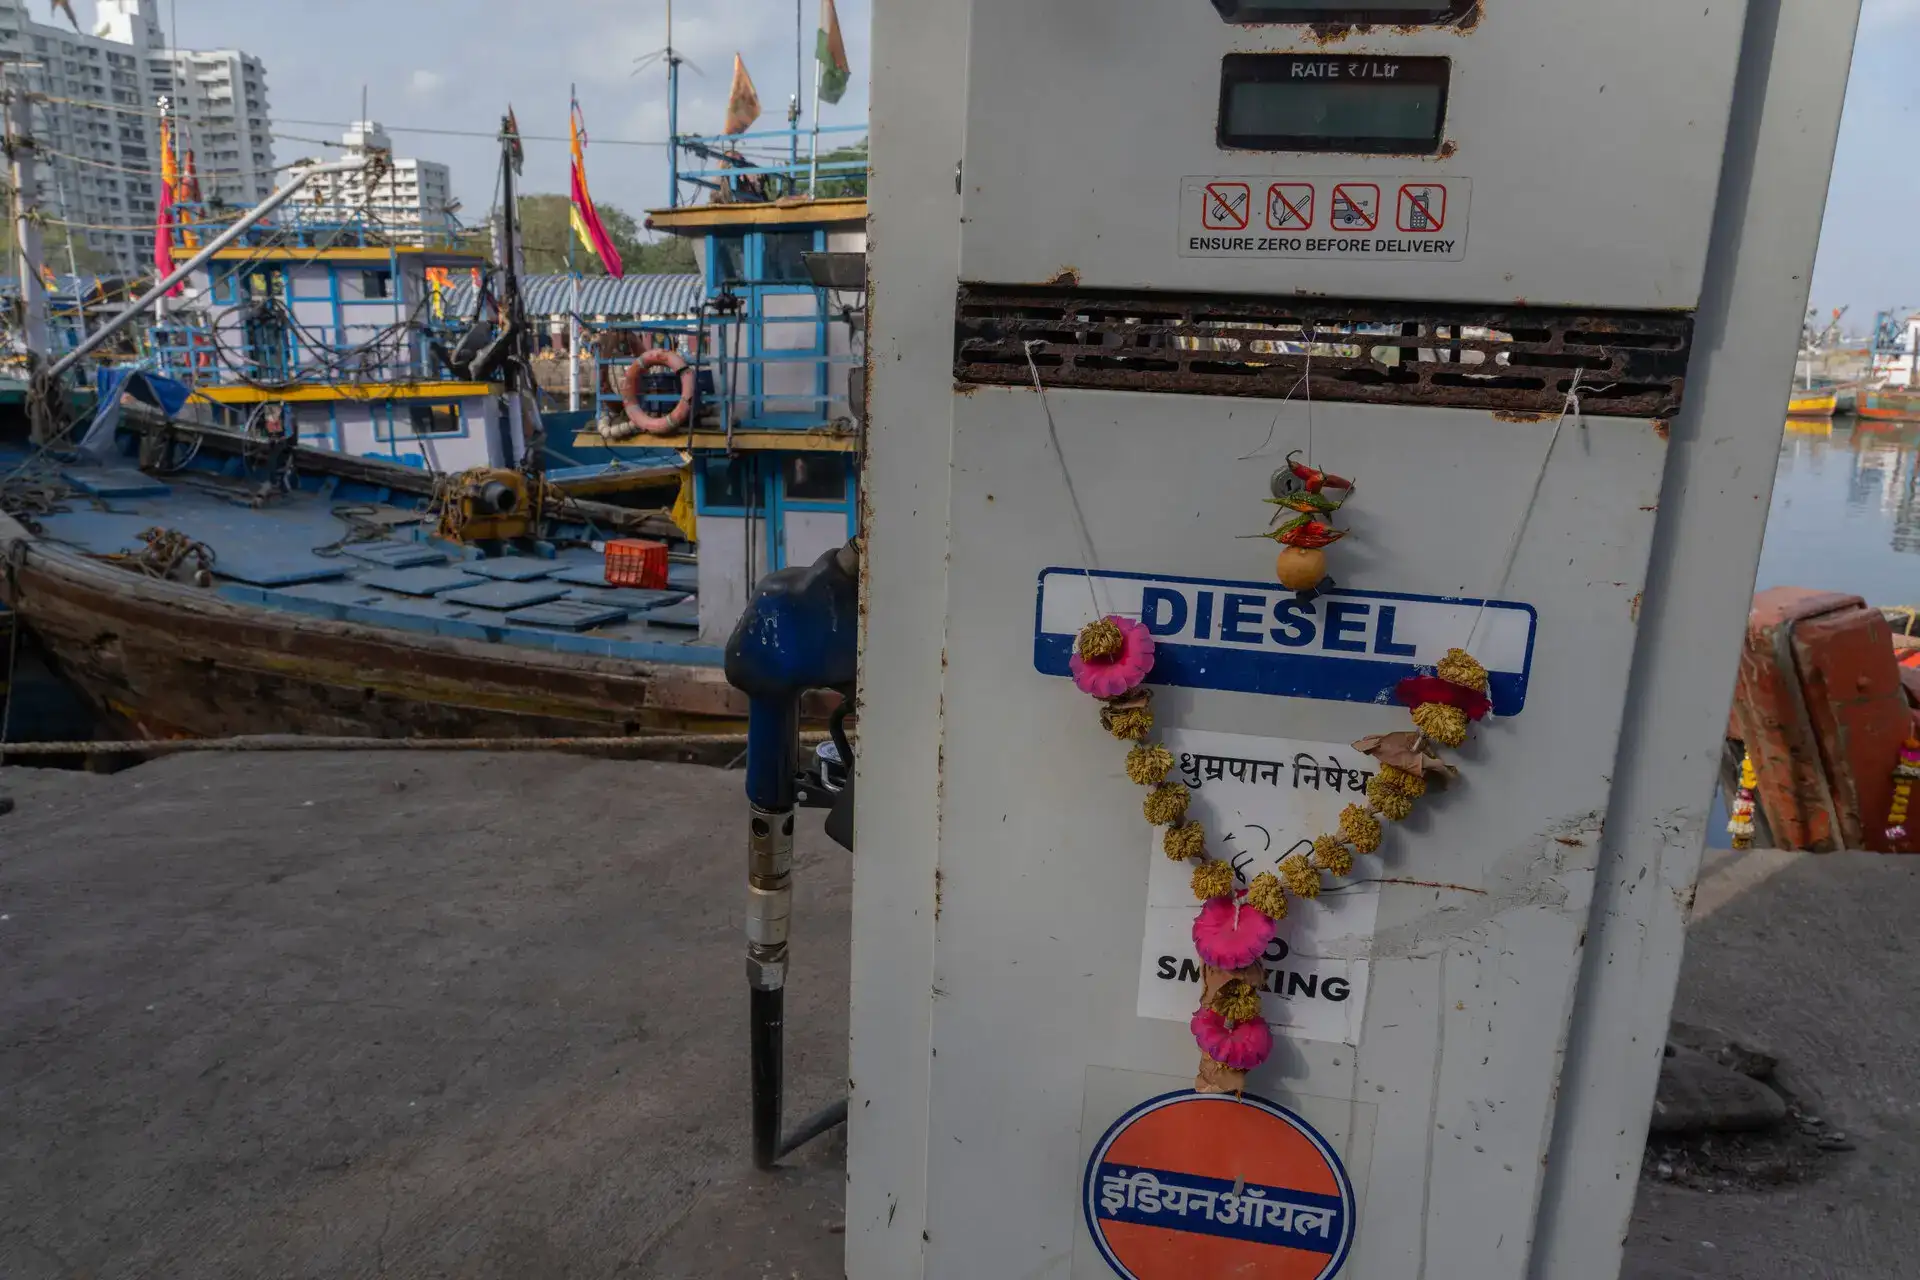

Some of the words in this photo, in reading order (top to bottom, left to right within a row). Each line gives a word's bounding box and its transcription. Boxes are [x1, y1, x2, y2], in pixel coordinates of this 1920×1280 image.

[1291, 62, 1339, 77] RATE
[1189, 237, 1254, 250] ENSURE
[1257, 238, 1302, 251] ZERO
[1305, 239, 1371, 252] BEFORE
[1375, 240, 1455, 254] DELIVERY
[1142, 587, 1417, 657] DIESEL
[1292, 752, 1374, 795] निषेध
[1100, 1169, 1337, 1239] इंडियनऑयल
